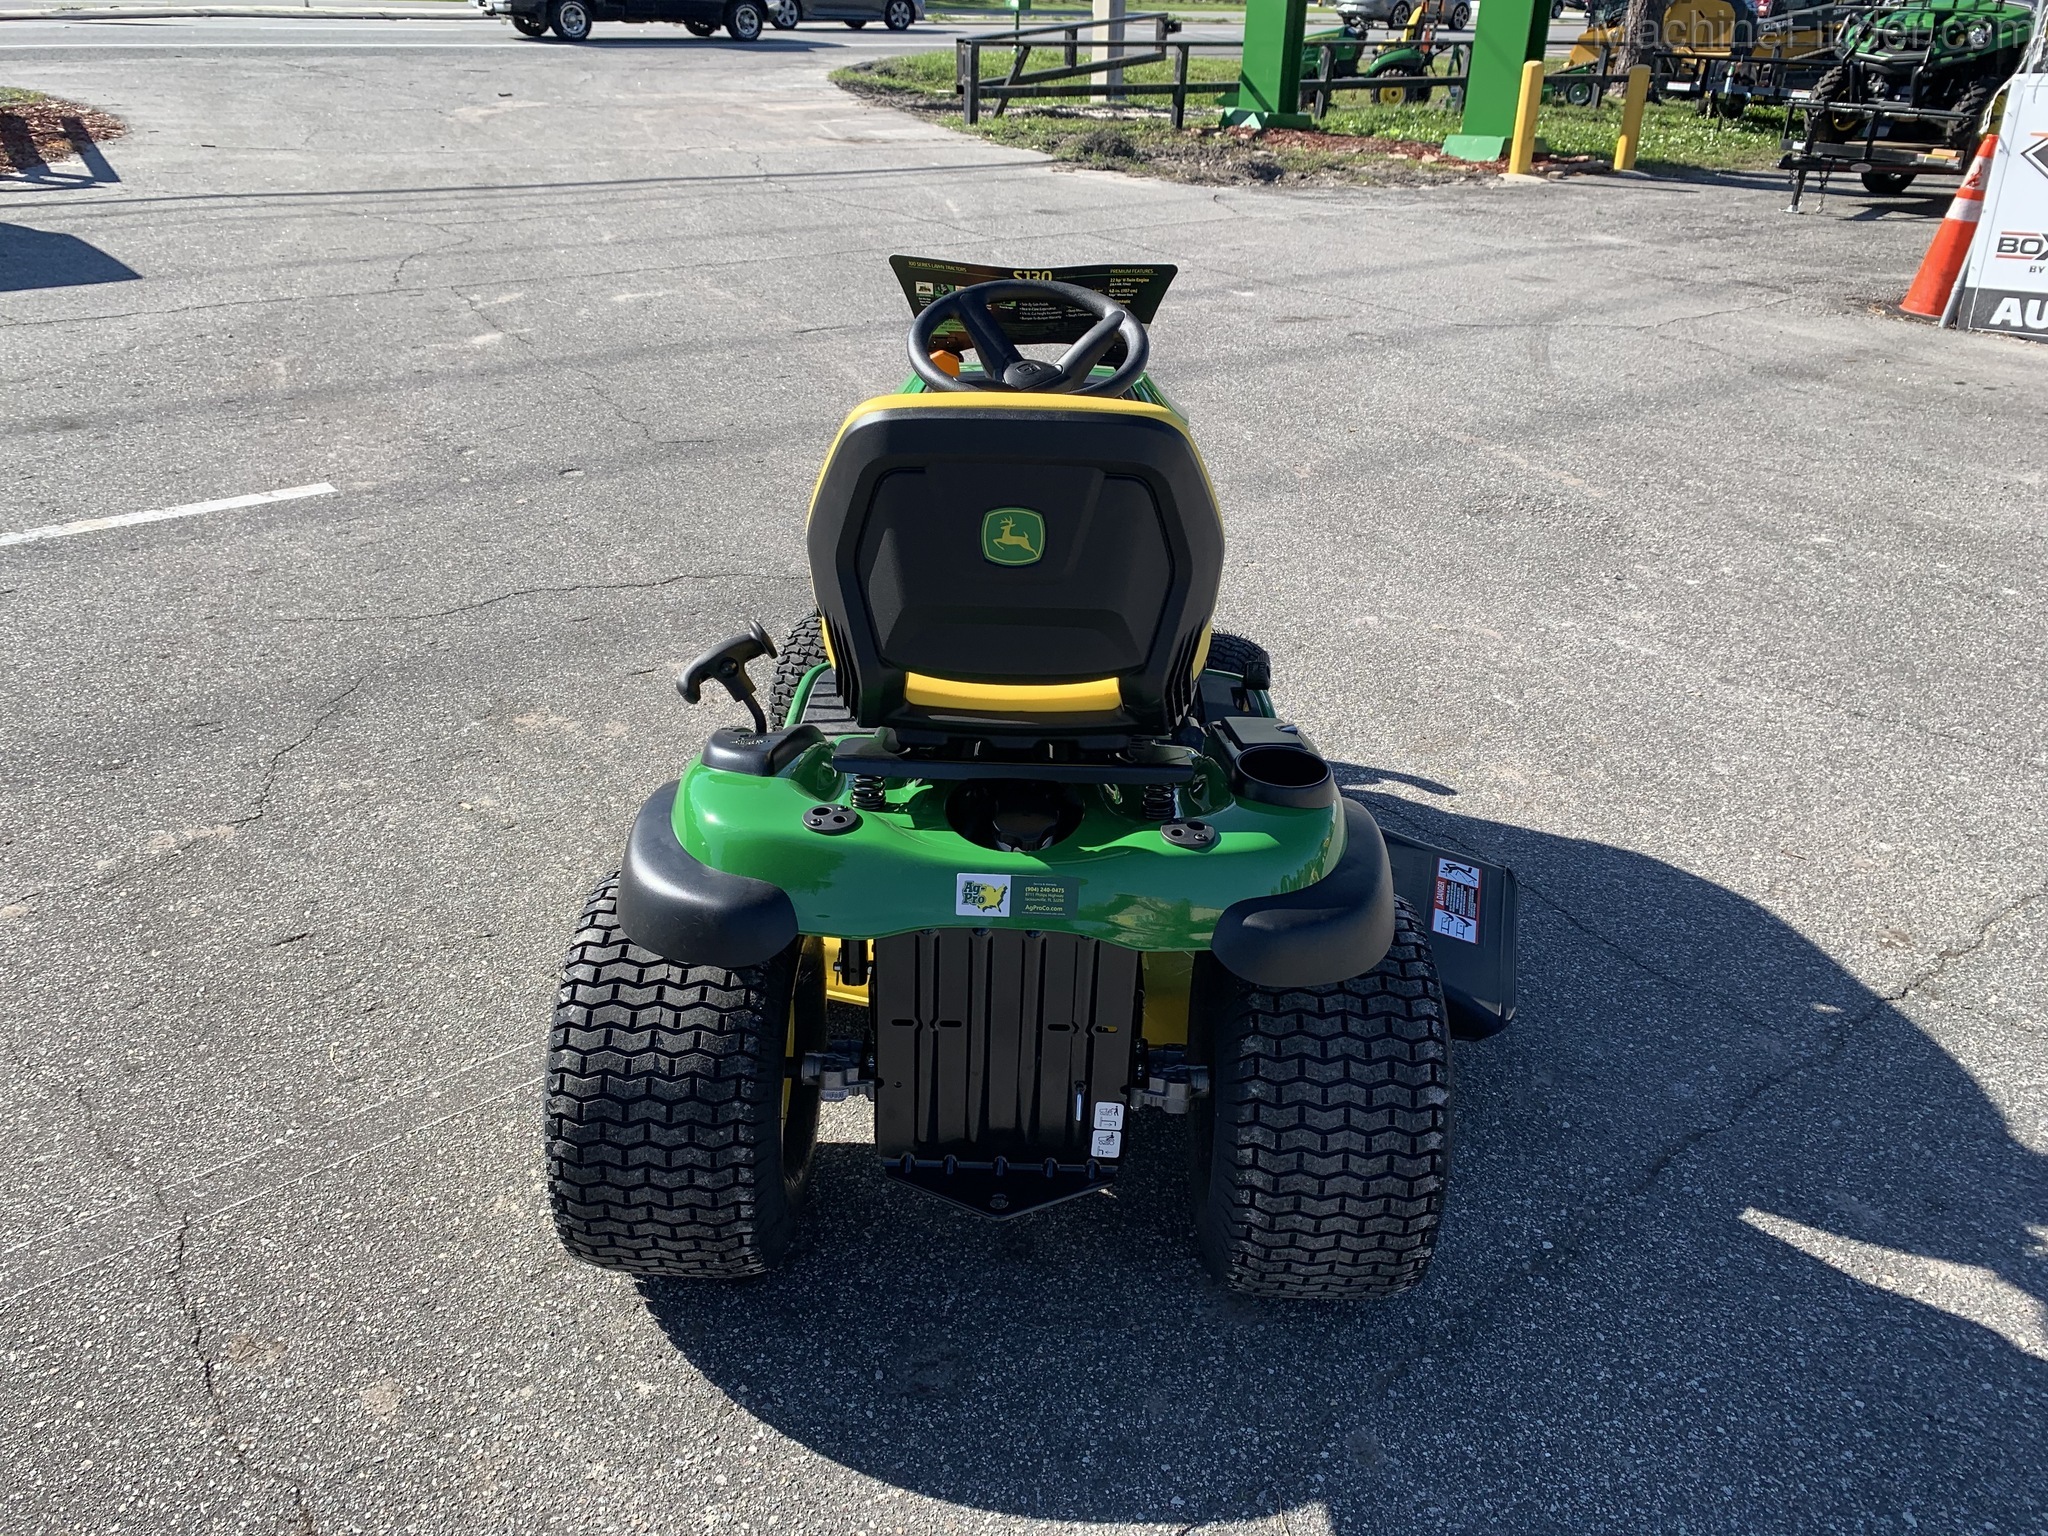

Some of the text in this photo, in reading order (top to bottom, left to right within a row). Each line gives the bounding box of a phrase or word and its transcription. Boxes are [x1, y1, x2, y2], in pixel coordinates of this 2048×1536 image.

[1763, 18, 1794, 31] DEERE
[1436, 880, 1445, 900] DANGER
[963, 893, 986, 904] Pro
[1025, 904, 1063, 912] AgProCo.com
